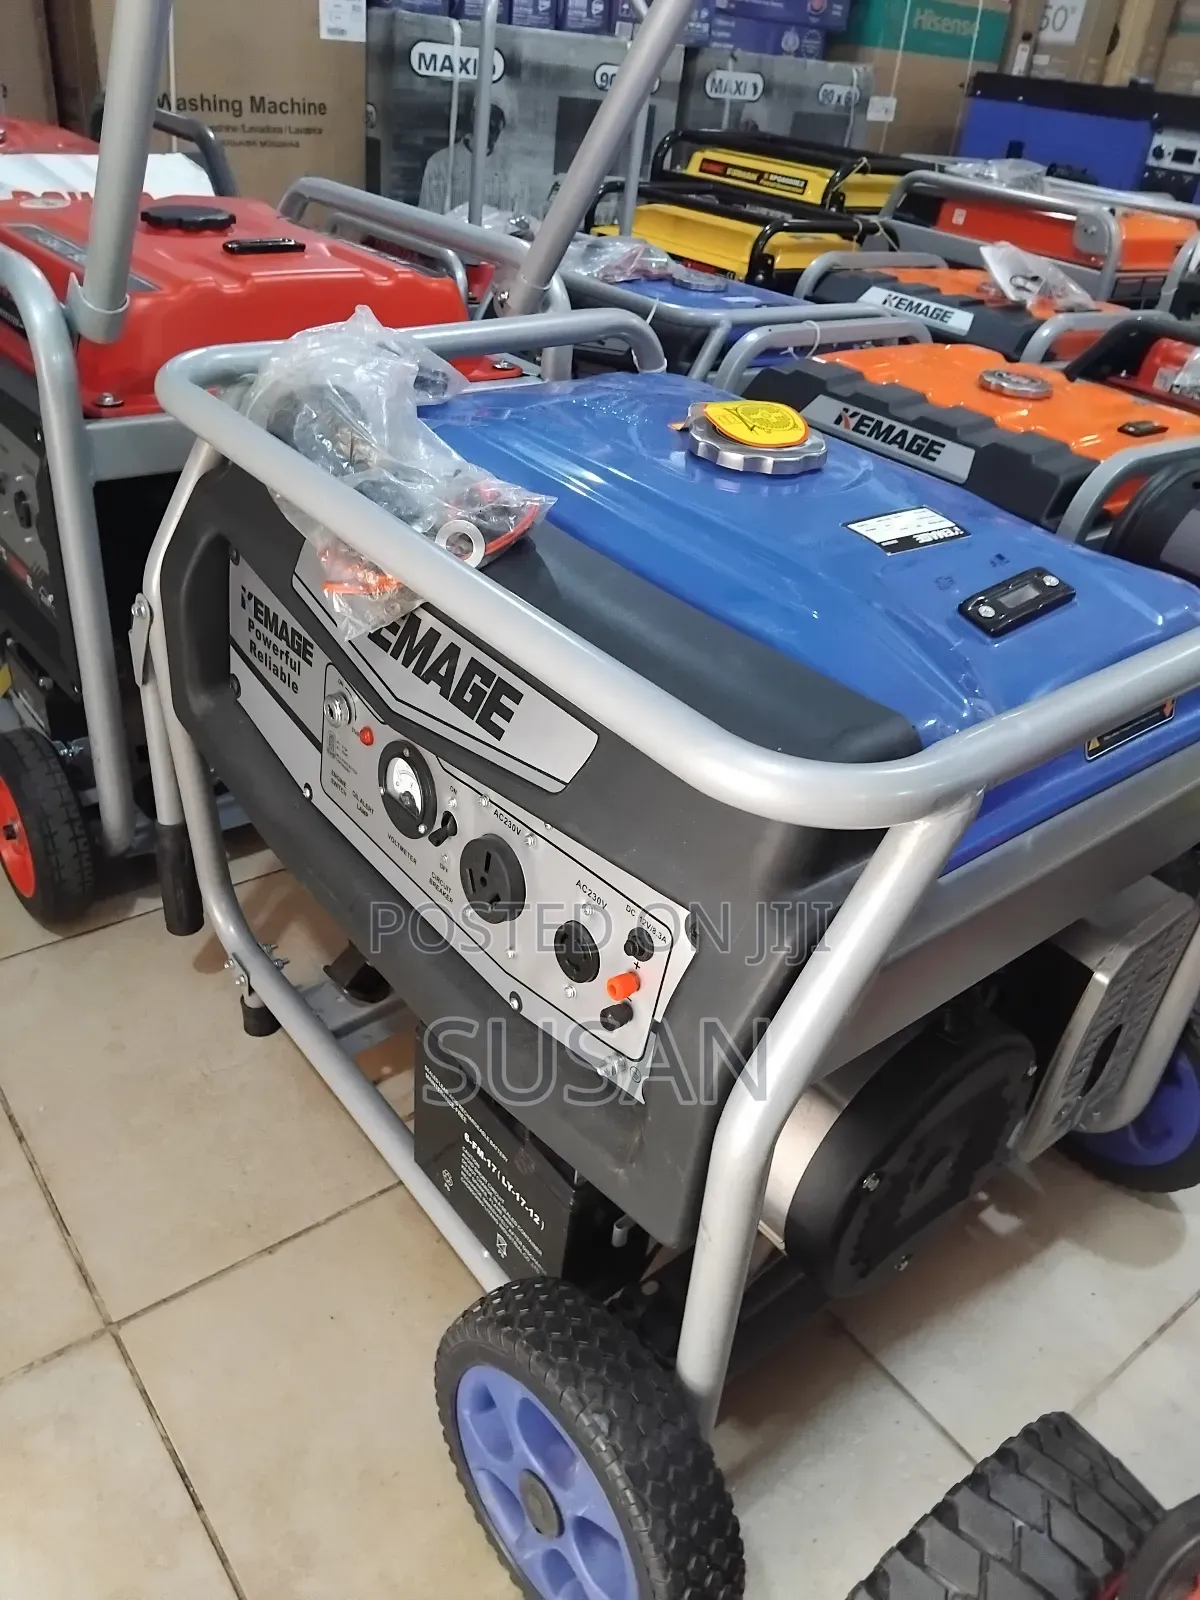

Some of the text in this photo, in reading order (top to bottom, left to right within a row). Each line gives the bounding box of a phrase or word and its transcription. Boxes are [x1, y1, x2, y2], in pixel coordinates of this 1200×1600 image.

[250, 95, 328, 116] Machine
[882, 293, 955, 324] KEMAGE
[834, 407, 946, 462] KEMAGE
[240, 584, 315, 668] KEMAGE
[247, 617, 301, 677] Powerful
[249, 639, 299, 695] Reliable
[367, 611, 525, 742] EMAGE
[450, 785, 458, 795] ON
[493, 809, 522, 836] AC230V
[387, 832, 417, 866] VOLTMETER
[431, 871, 452, 894] CIRCUIT
[575, 879, 608, 910] AC230V
[625, 904, 667, 944] DC 12V/8.3A
